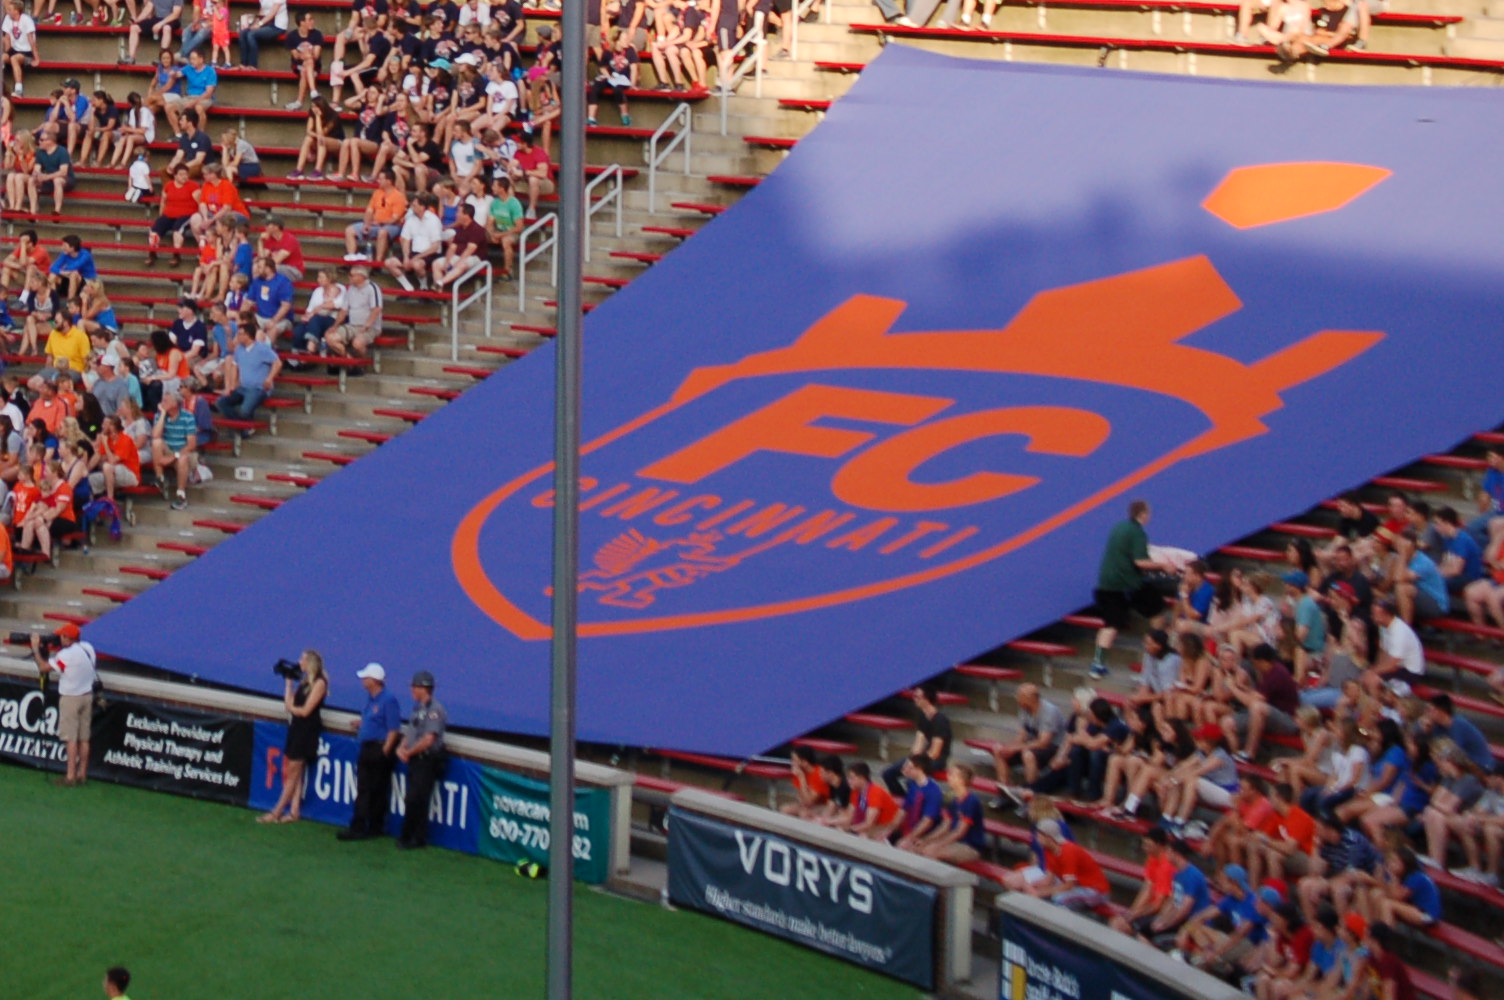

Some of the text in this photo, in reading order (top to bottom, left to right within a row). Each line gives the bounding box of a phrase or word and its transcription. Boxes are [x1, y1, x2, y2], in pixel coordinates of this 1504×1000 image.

[634, 384, 1111, 513] FC
[531, 477, 980, 559] CINCINNATI
[124, 732, 224, 764] Physical Therapy and
[126, 712, 224, 743] Exclusive Provider of
[104, 749, 143, 769] Athletic
[145, 756, 183, 780] Training
[184, 763, 222, 784] Services
[735, 830, 874, 914] VORYS
